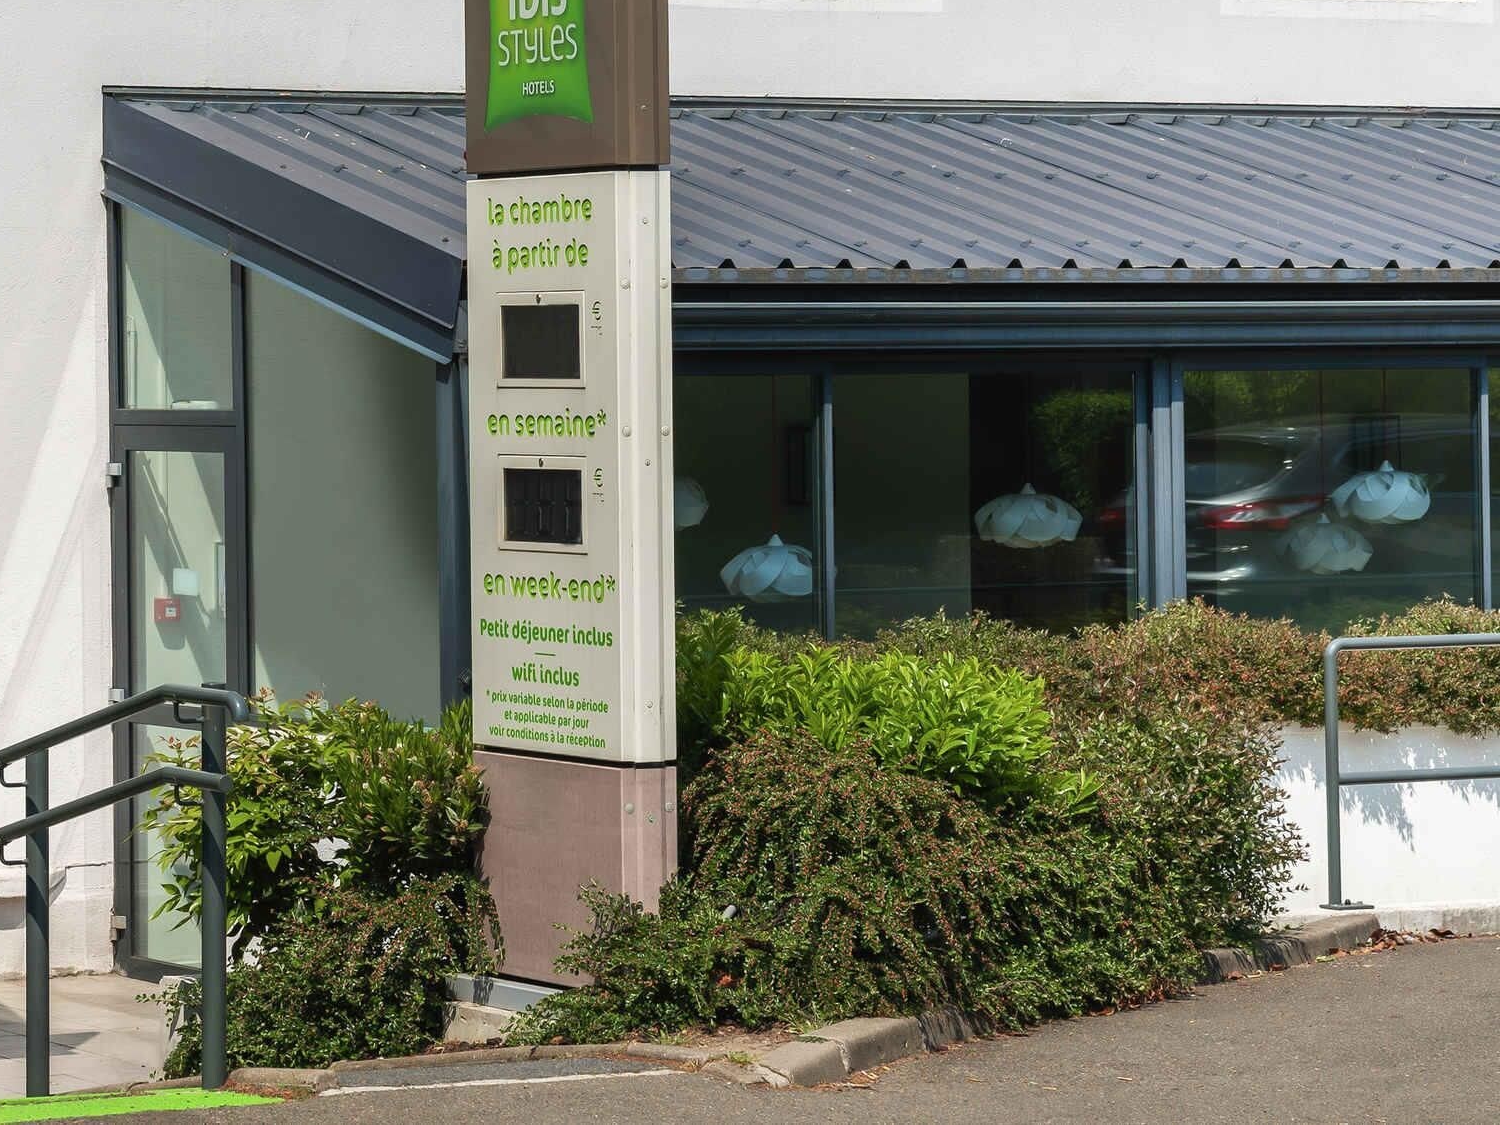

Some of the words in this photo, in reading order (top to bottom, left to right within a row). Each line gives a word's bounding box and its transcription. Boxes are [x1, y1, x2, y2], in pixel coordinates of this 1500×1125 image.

[522, 79, 555, 96] HOTELS
[487, 198, 505, 226] la
[509, 193, 594, 225] chambre
[491, 239, 502, 269] à
[507, 237, 562, 275] partir
[564, 237, 589, 268] de
[487, 412, 510, 436] en
[483, 573, 506, 596] en
[480, 618, 509, 638] Petit
[511, 619, 570, 645] déjeuner
[572, 624, 613, 648] inclus
[511, 662, 537, 683] wifi
[539, 663, 580, 687] inclus
[491, 690, 507, 703] prix
[508, 693, 541, 707] variable
[542, 695, 565, 709] selon
[566, 697, 575, 709] la
[576, 698, 609, 713] période
[504, 710, 512, 720] et
[514, 710, 556, 725] applicable
[557, 716, 571, 728] par
[572, 715, 589, 730] jour
[489, 724, 505, 737] voir
[506, 725, 549, 741] conditions
[557, 731, 565, 744] la
[566, 732, 606, 748] réception
